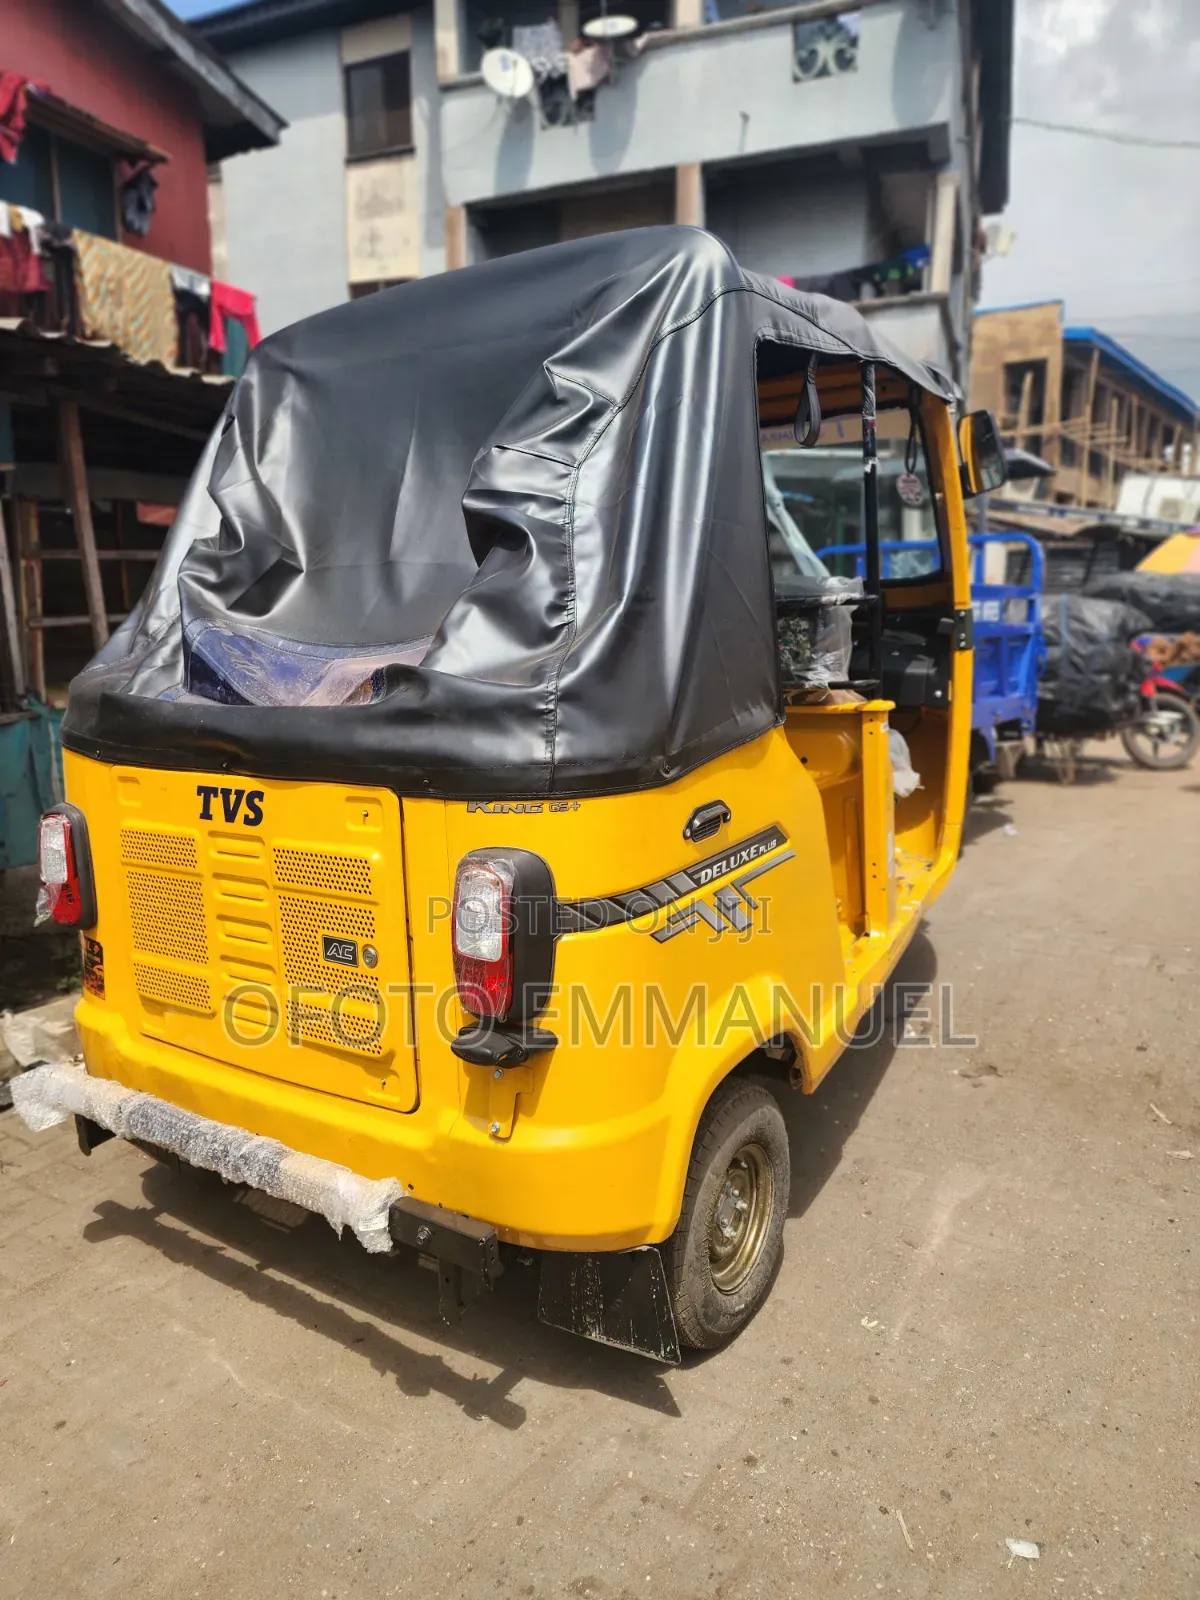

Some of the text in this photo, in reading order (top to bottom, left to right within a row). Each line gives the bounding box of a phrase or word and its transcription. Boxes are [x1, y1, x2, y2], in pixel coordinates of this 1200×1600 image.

[196, 785, 265, 827] TVS
[700, 838, 777, 885] DELUXE PLUS
[326, 942, 354, 961] AC
